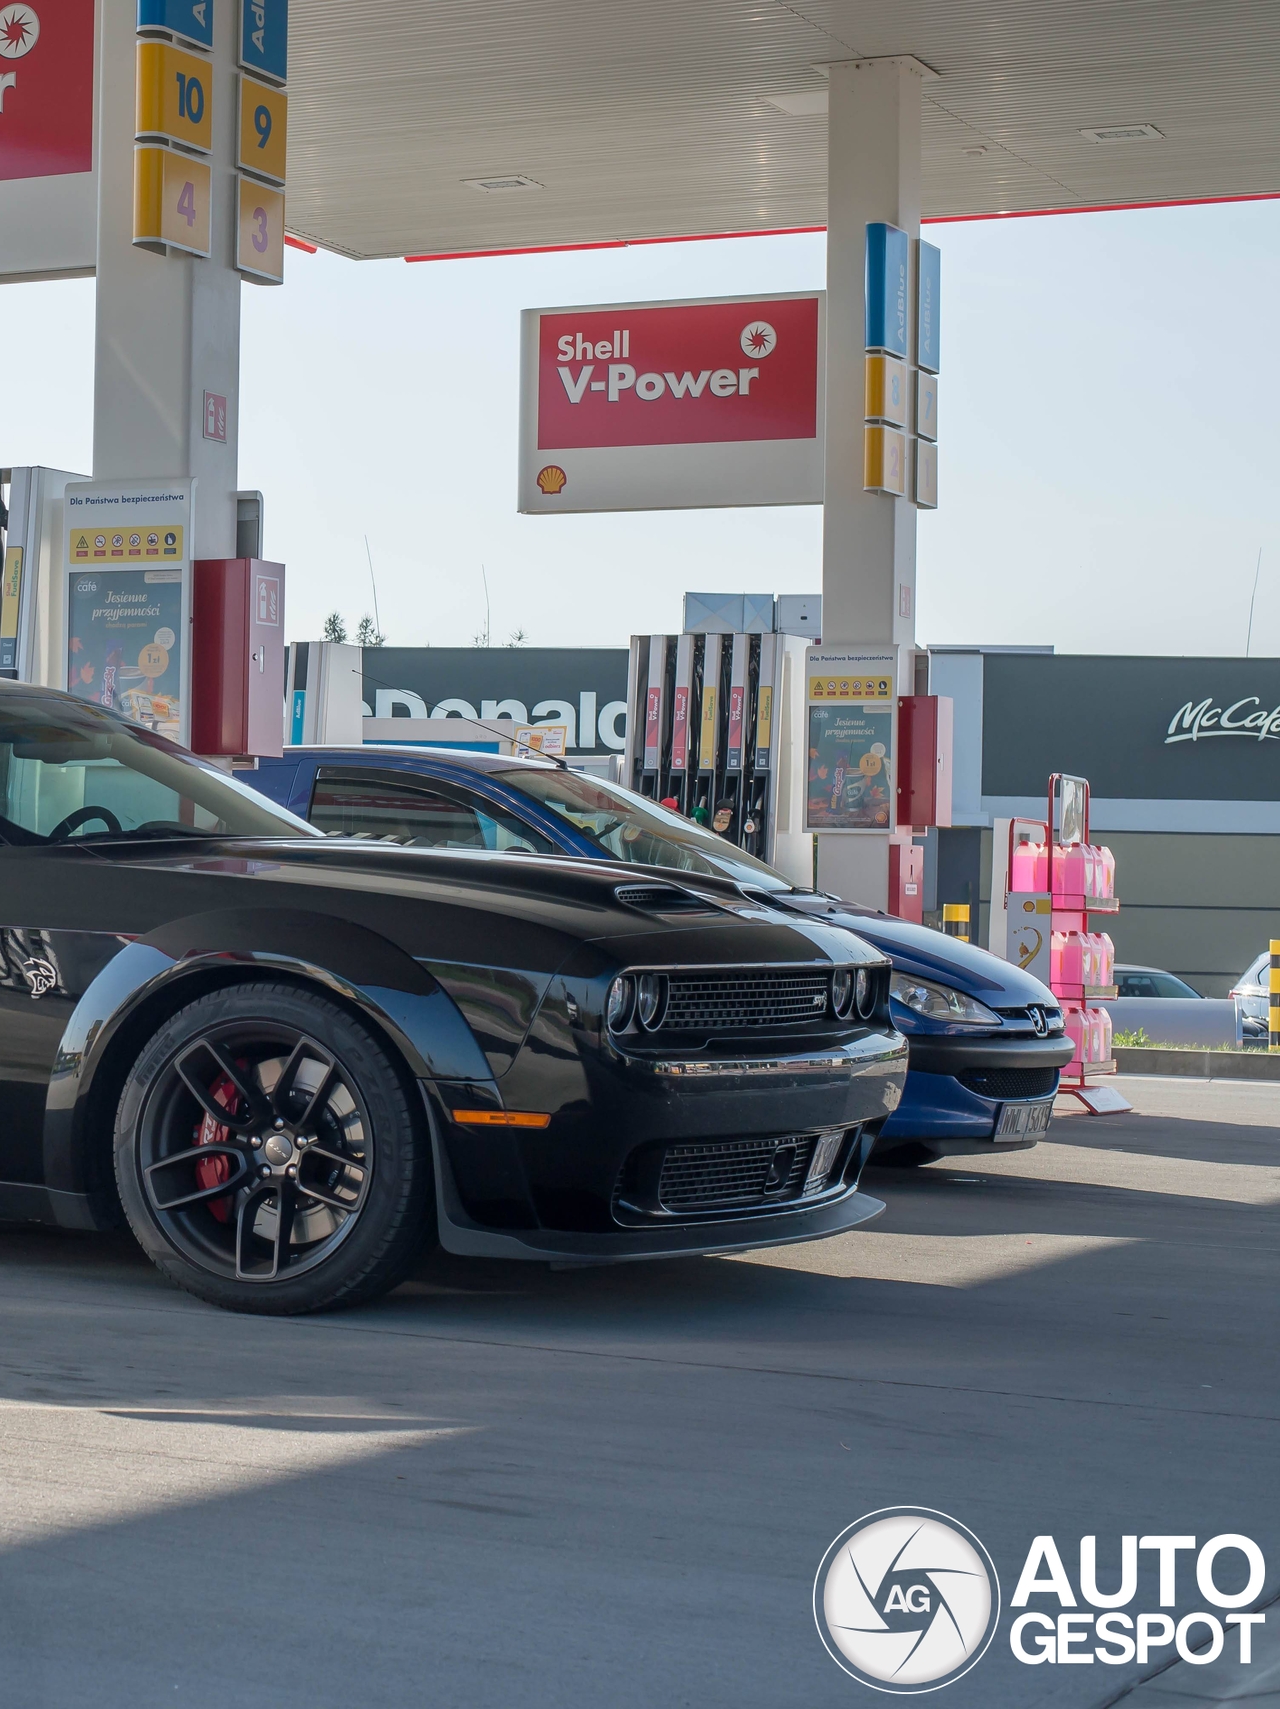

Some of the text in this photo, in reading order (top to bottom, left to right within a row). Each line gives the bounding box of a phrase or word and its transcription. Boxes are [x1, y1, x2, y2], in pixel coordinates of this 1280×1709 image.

[176, 72, 205, 124] 10
[254, 104, 272, 149] 9
[176, 181, 196, 228] 4
[251, 206, 268, 253] 3
[897, 263, 906, 343] AdBlue
[923, 276, 931, 355] AdBlue
[556, 329, 630, 362] Shell
[556, 363, 760, 404] V-Power
[891, 374, 900, 406] 8
[925, 389, 933, 420] 7
[890, 445, 899, 477] 2
[924, 458, 930, 487] 1
[70, 494, 184, 505] Dla Państwa bezpieczeństwa
[11, 560, 20, 597] FuelSave
[77, 581, 97, 592] café
[91, 603, 161, 621] przyjemności
[105, 590, 148, 604] Jesienne
